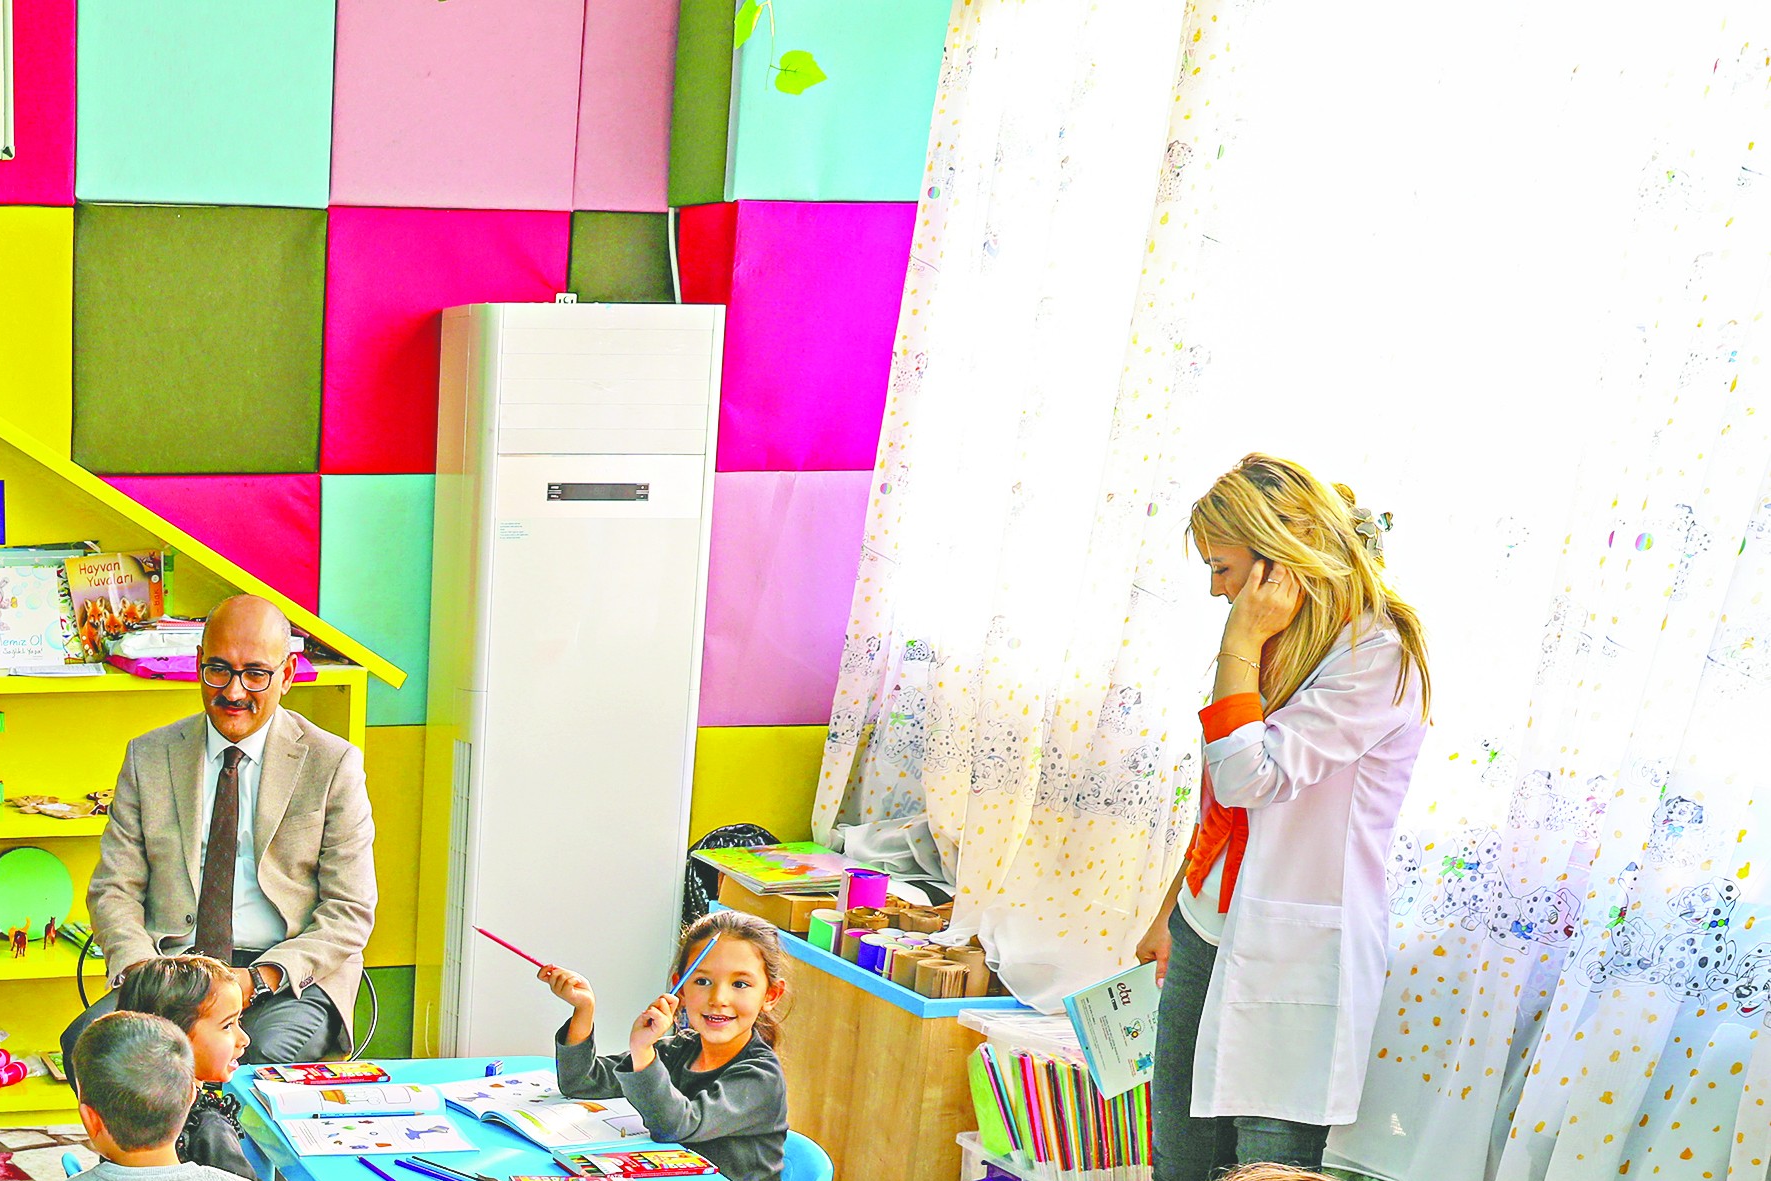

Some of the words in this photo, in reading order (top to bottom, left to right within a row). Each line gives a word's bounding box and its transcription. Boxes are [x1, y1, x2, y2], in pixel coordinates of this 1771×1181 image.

[78, 560, 121, 577] Hayvan
[86, 573, 134, 587] Yuvaları
[29, 634, 43, 646] Ol
